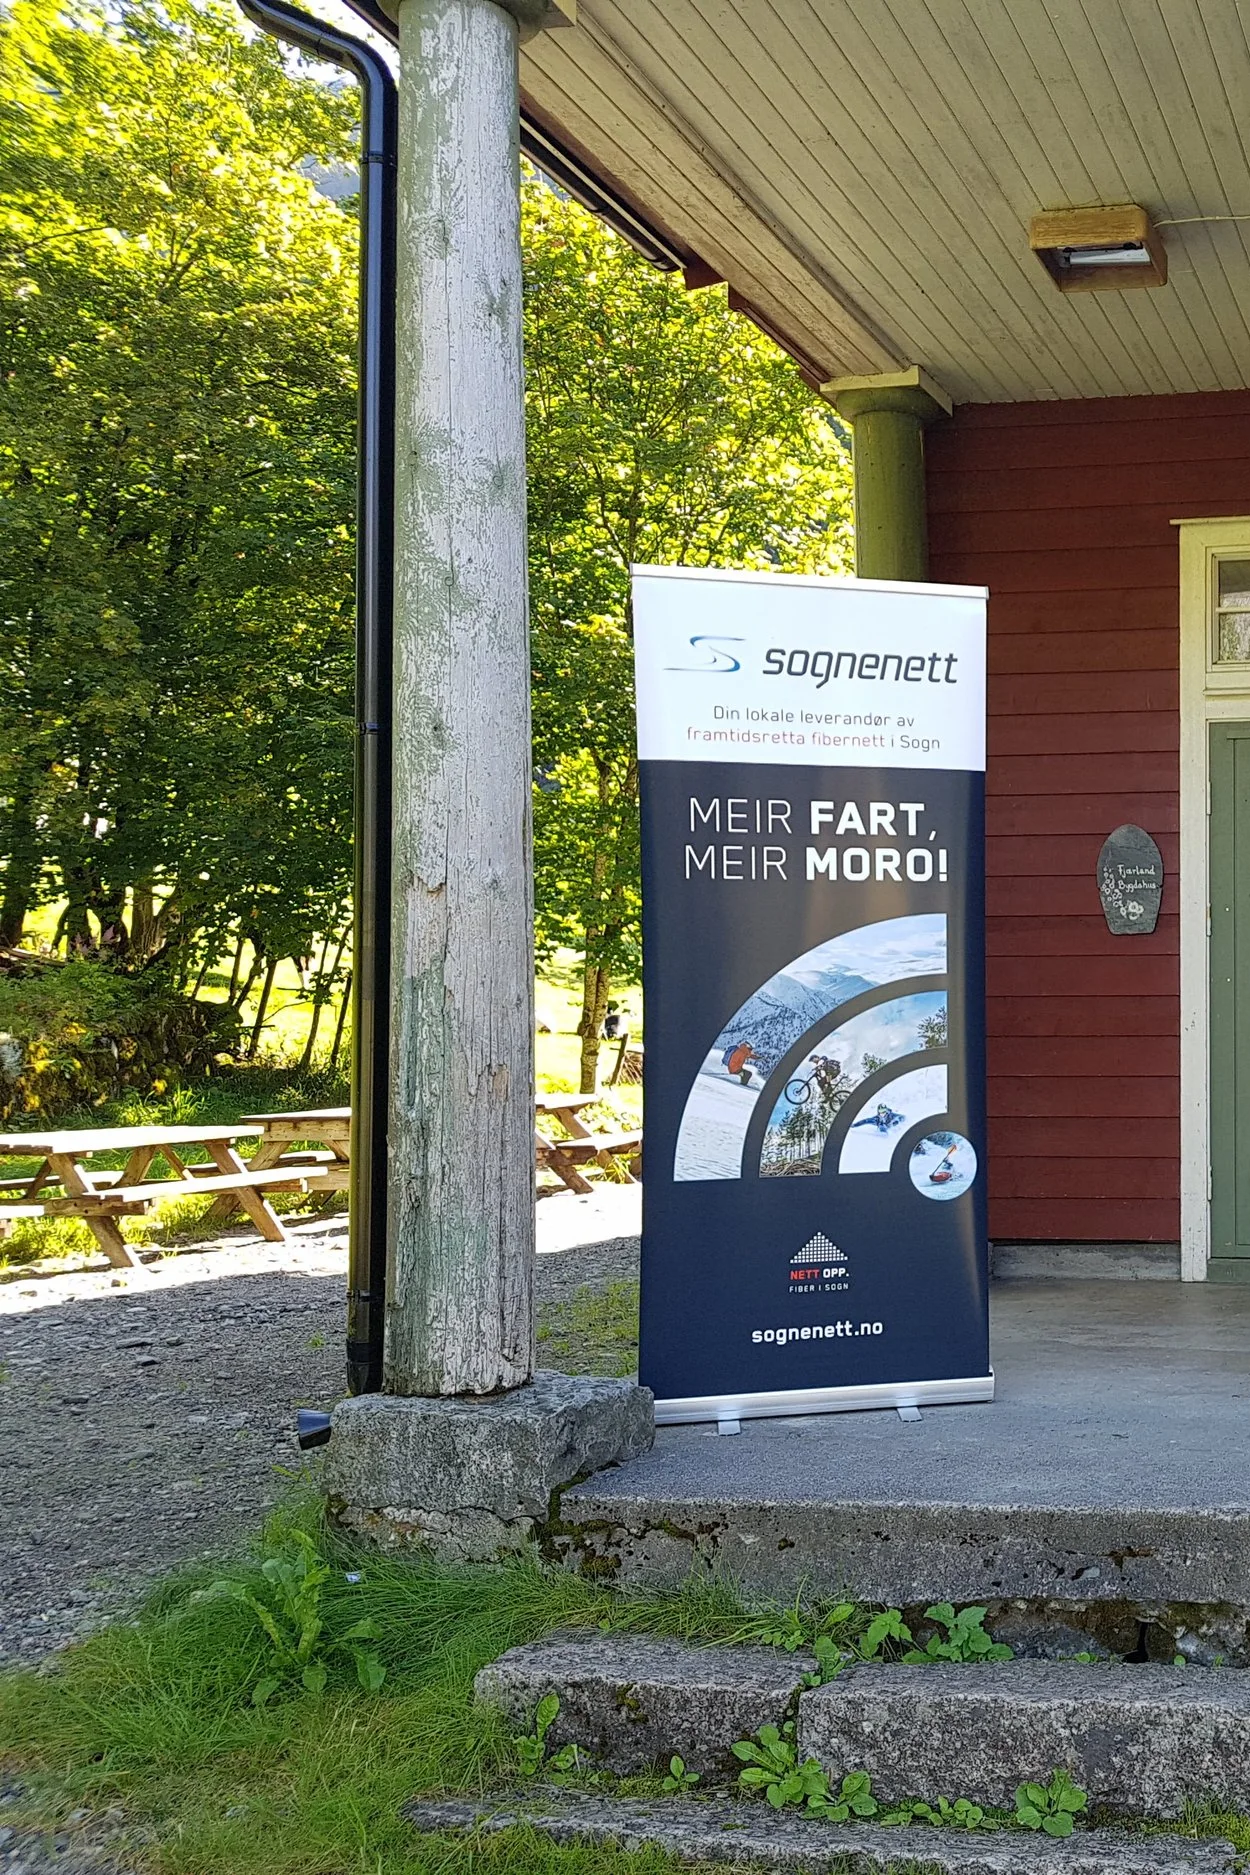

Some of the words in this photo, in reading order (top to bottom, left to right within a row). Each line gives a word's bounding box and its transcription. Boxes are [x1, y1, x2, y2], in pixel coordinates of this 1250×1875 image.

[762, 648, 958, 688] sognenett
[713, 706, 740, 721] Din
[746, 707, 795, 723] lokale
[800, 709, 891, 726] leverandør
[897, 716, 915, 727] av
[687, 726, 805, 745] framtidsretta
[812, 731, 885, 748] fibernett
[899, 734, 940, 752] Sogn
[689, 797, 792, 834] MEIR
[810, 800, 937, 841] FART,
[685, 844, 788, 880] MEIR
[805, 846, 948, 882] MORO!
[790, 1269, 820, 1280] NETT
[822, 1267, 850, 1278] OPP.
[788, 1284, 815, 1293] FIBER
[824, 1282, 849, 1291] SOGN
[751, 1320, 884, 1345] sognenett.no
